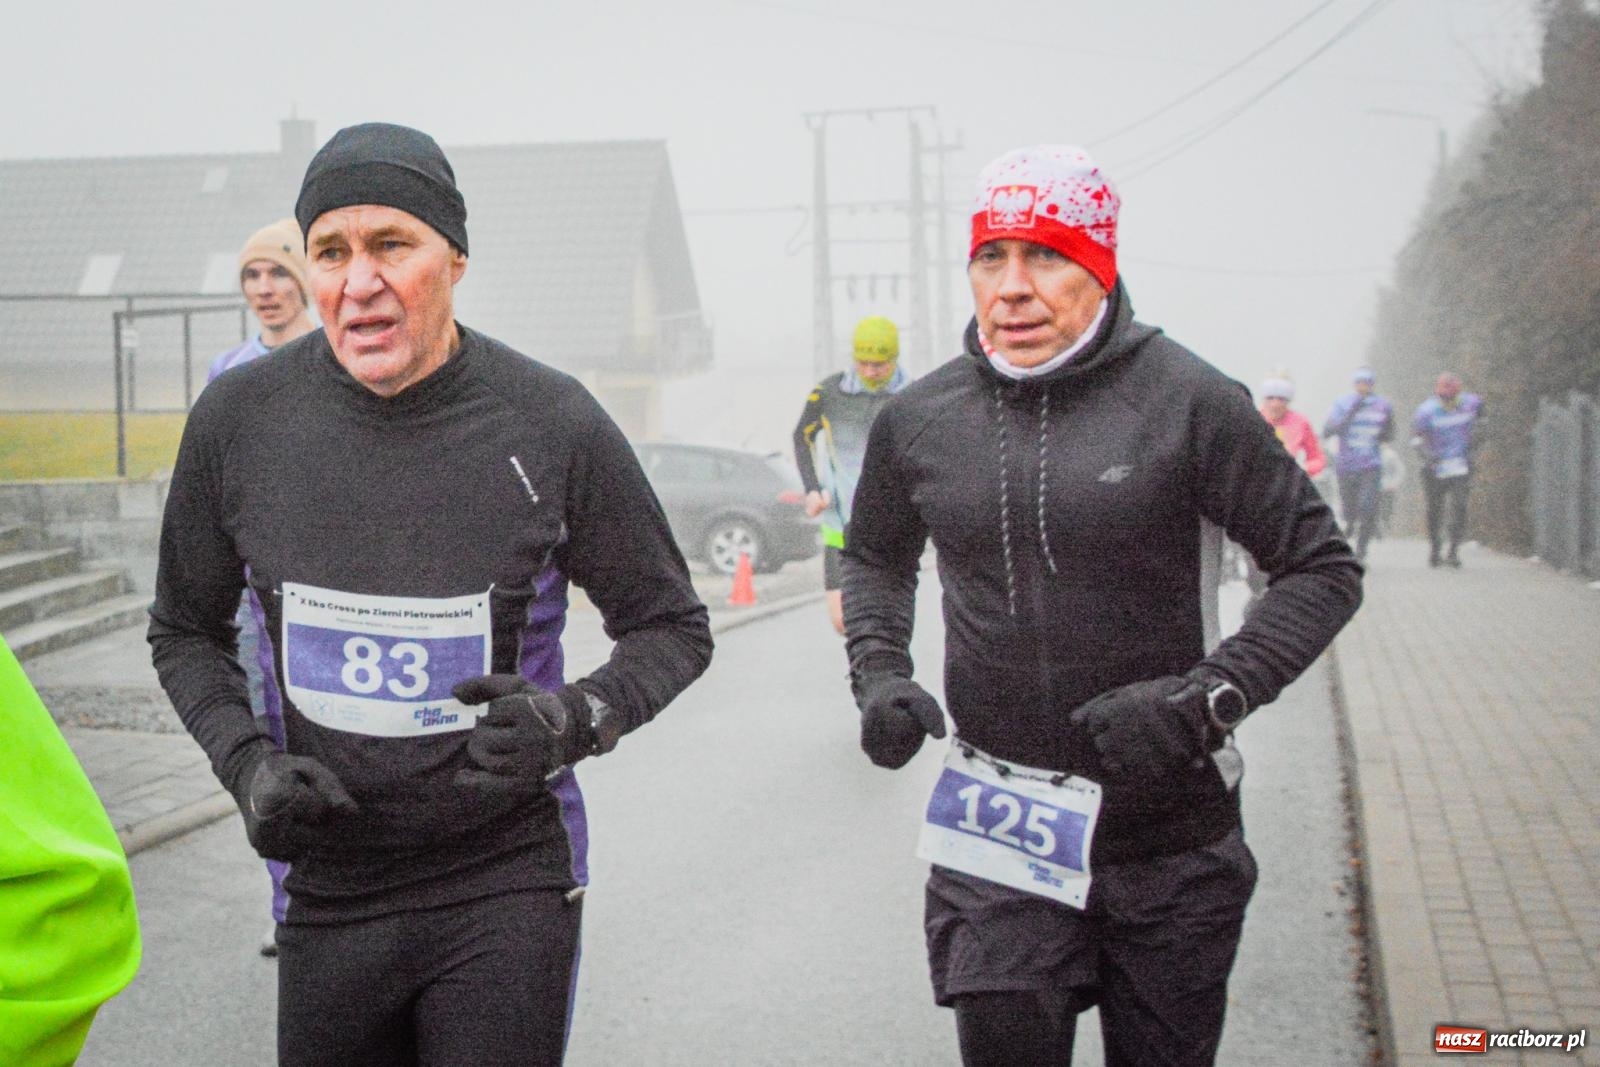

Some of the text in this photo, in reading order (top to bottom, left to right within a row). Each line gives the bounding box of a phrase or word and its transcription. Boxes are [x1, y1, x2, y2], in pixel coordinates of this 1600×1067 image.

[327, 602, 356, 613] Cross
[358, 608, 371, 616] po
[372, 607, 402, 618] Ziemi
[404, 606, 473, 619] Pietrowickiej
[341, 636, 430, 699] 83
[957, 784, 1059, 857] 125
